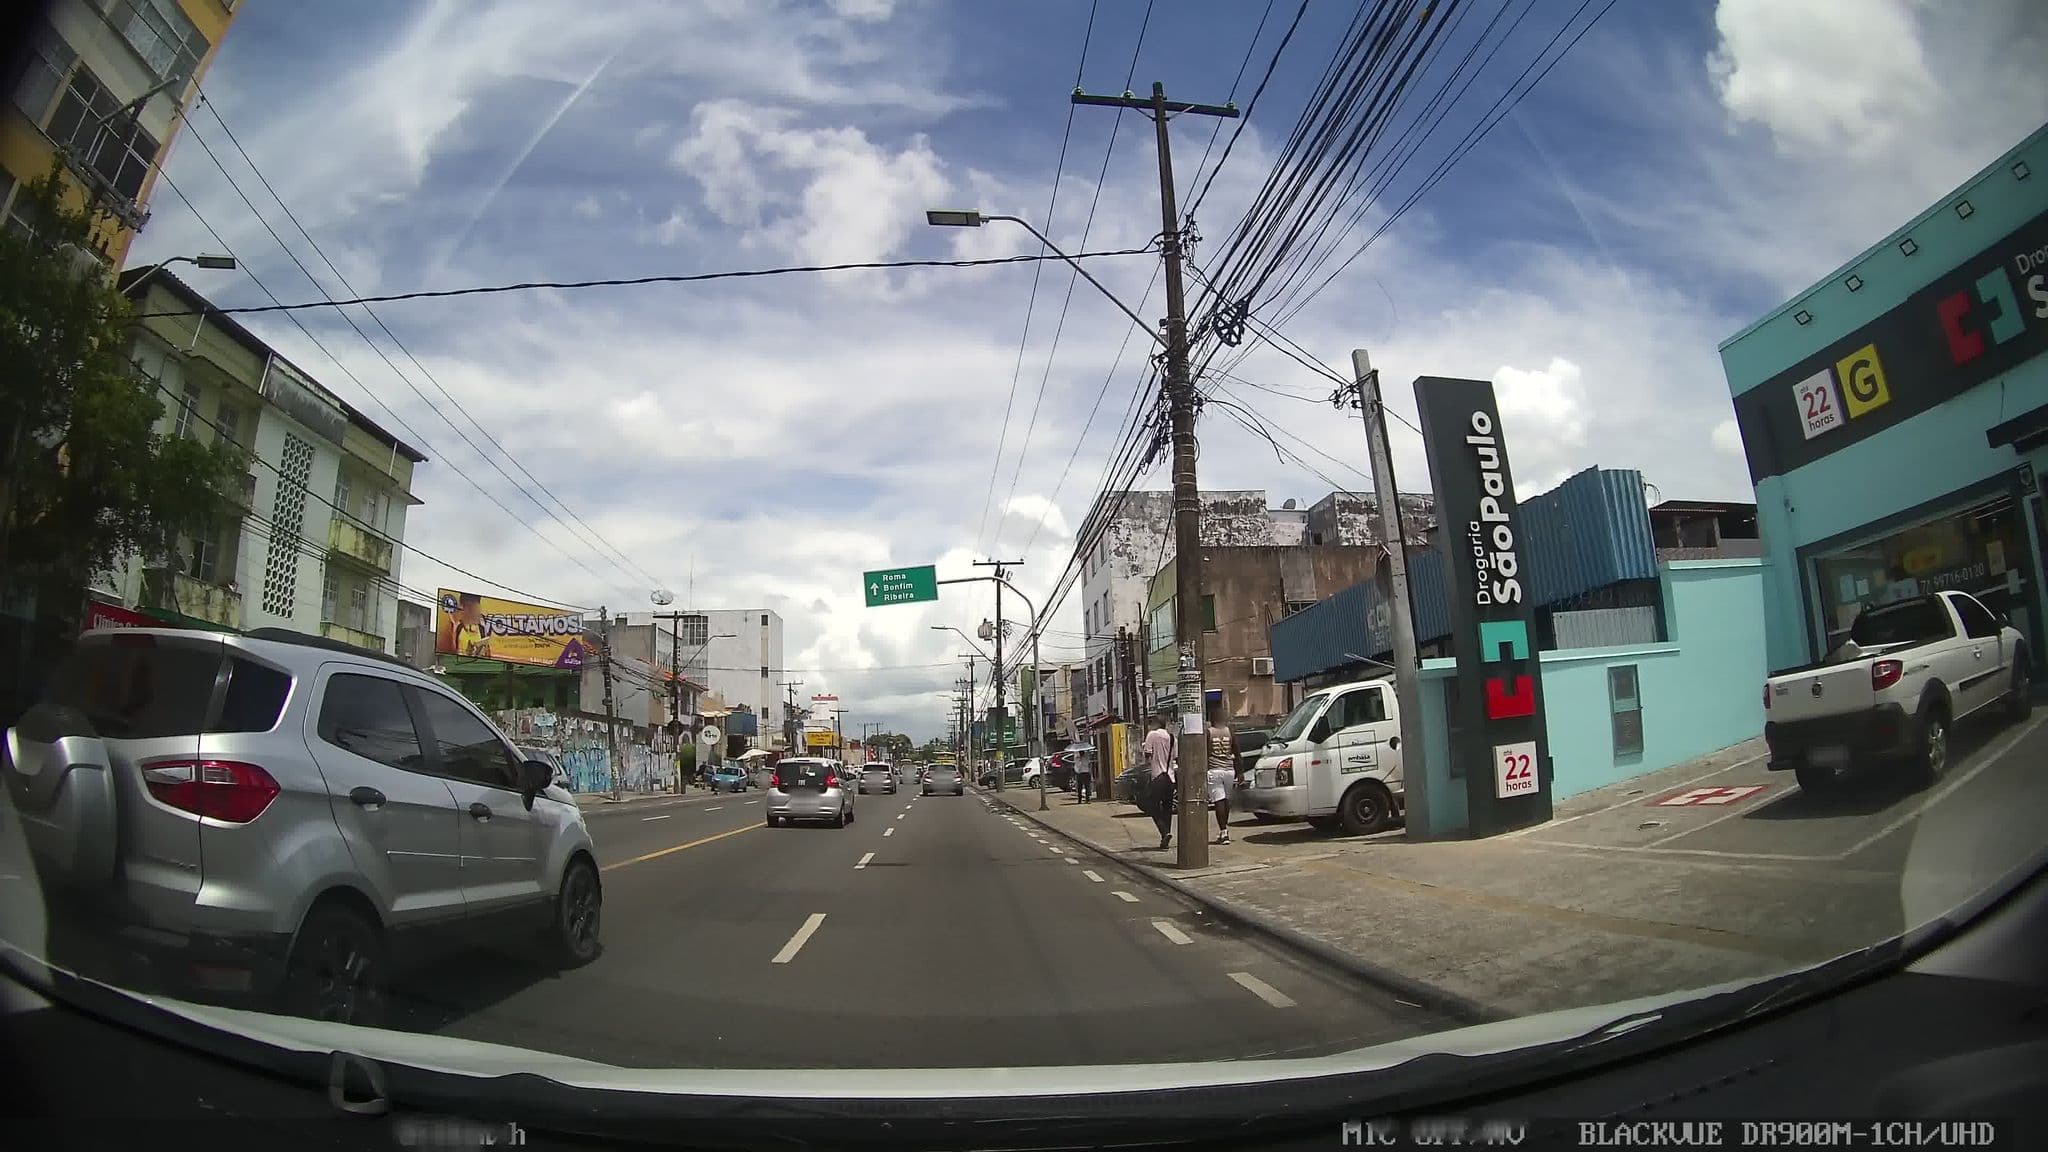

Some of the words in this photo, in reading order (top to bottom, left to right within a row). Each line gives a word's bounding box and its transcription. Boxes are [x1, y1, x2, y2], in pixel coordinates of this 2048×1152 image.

[1849, 359, 1879, 403] G
[1803, 386, 1831, 420] 22
[1808, 413, 1835, 432] horas
[1468, 521, 1491, 606] Drogaria
[882, 573, 906, 582] Roma
[883, 582, 913, 592] Bonfim
[884, 592, 914, 601] Ribeira
[481, 612, 584, 636] VOLTAMOS!
[1505, 754, 1531, 781] 22
[1506, 780, 1532, 793] horas
